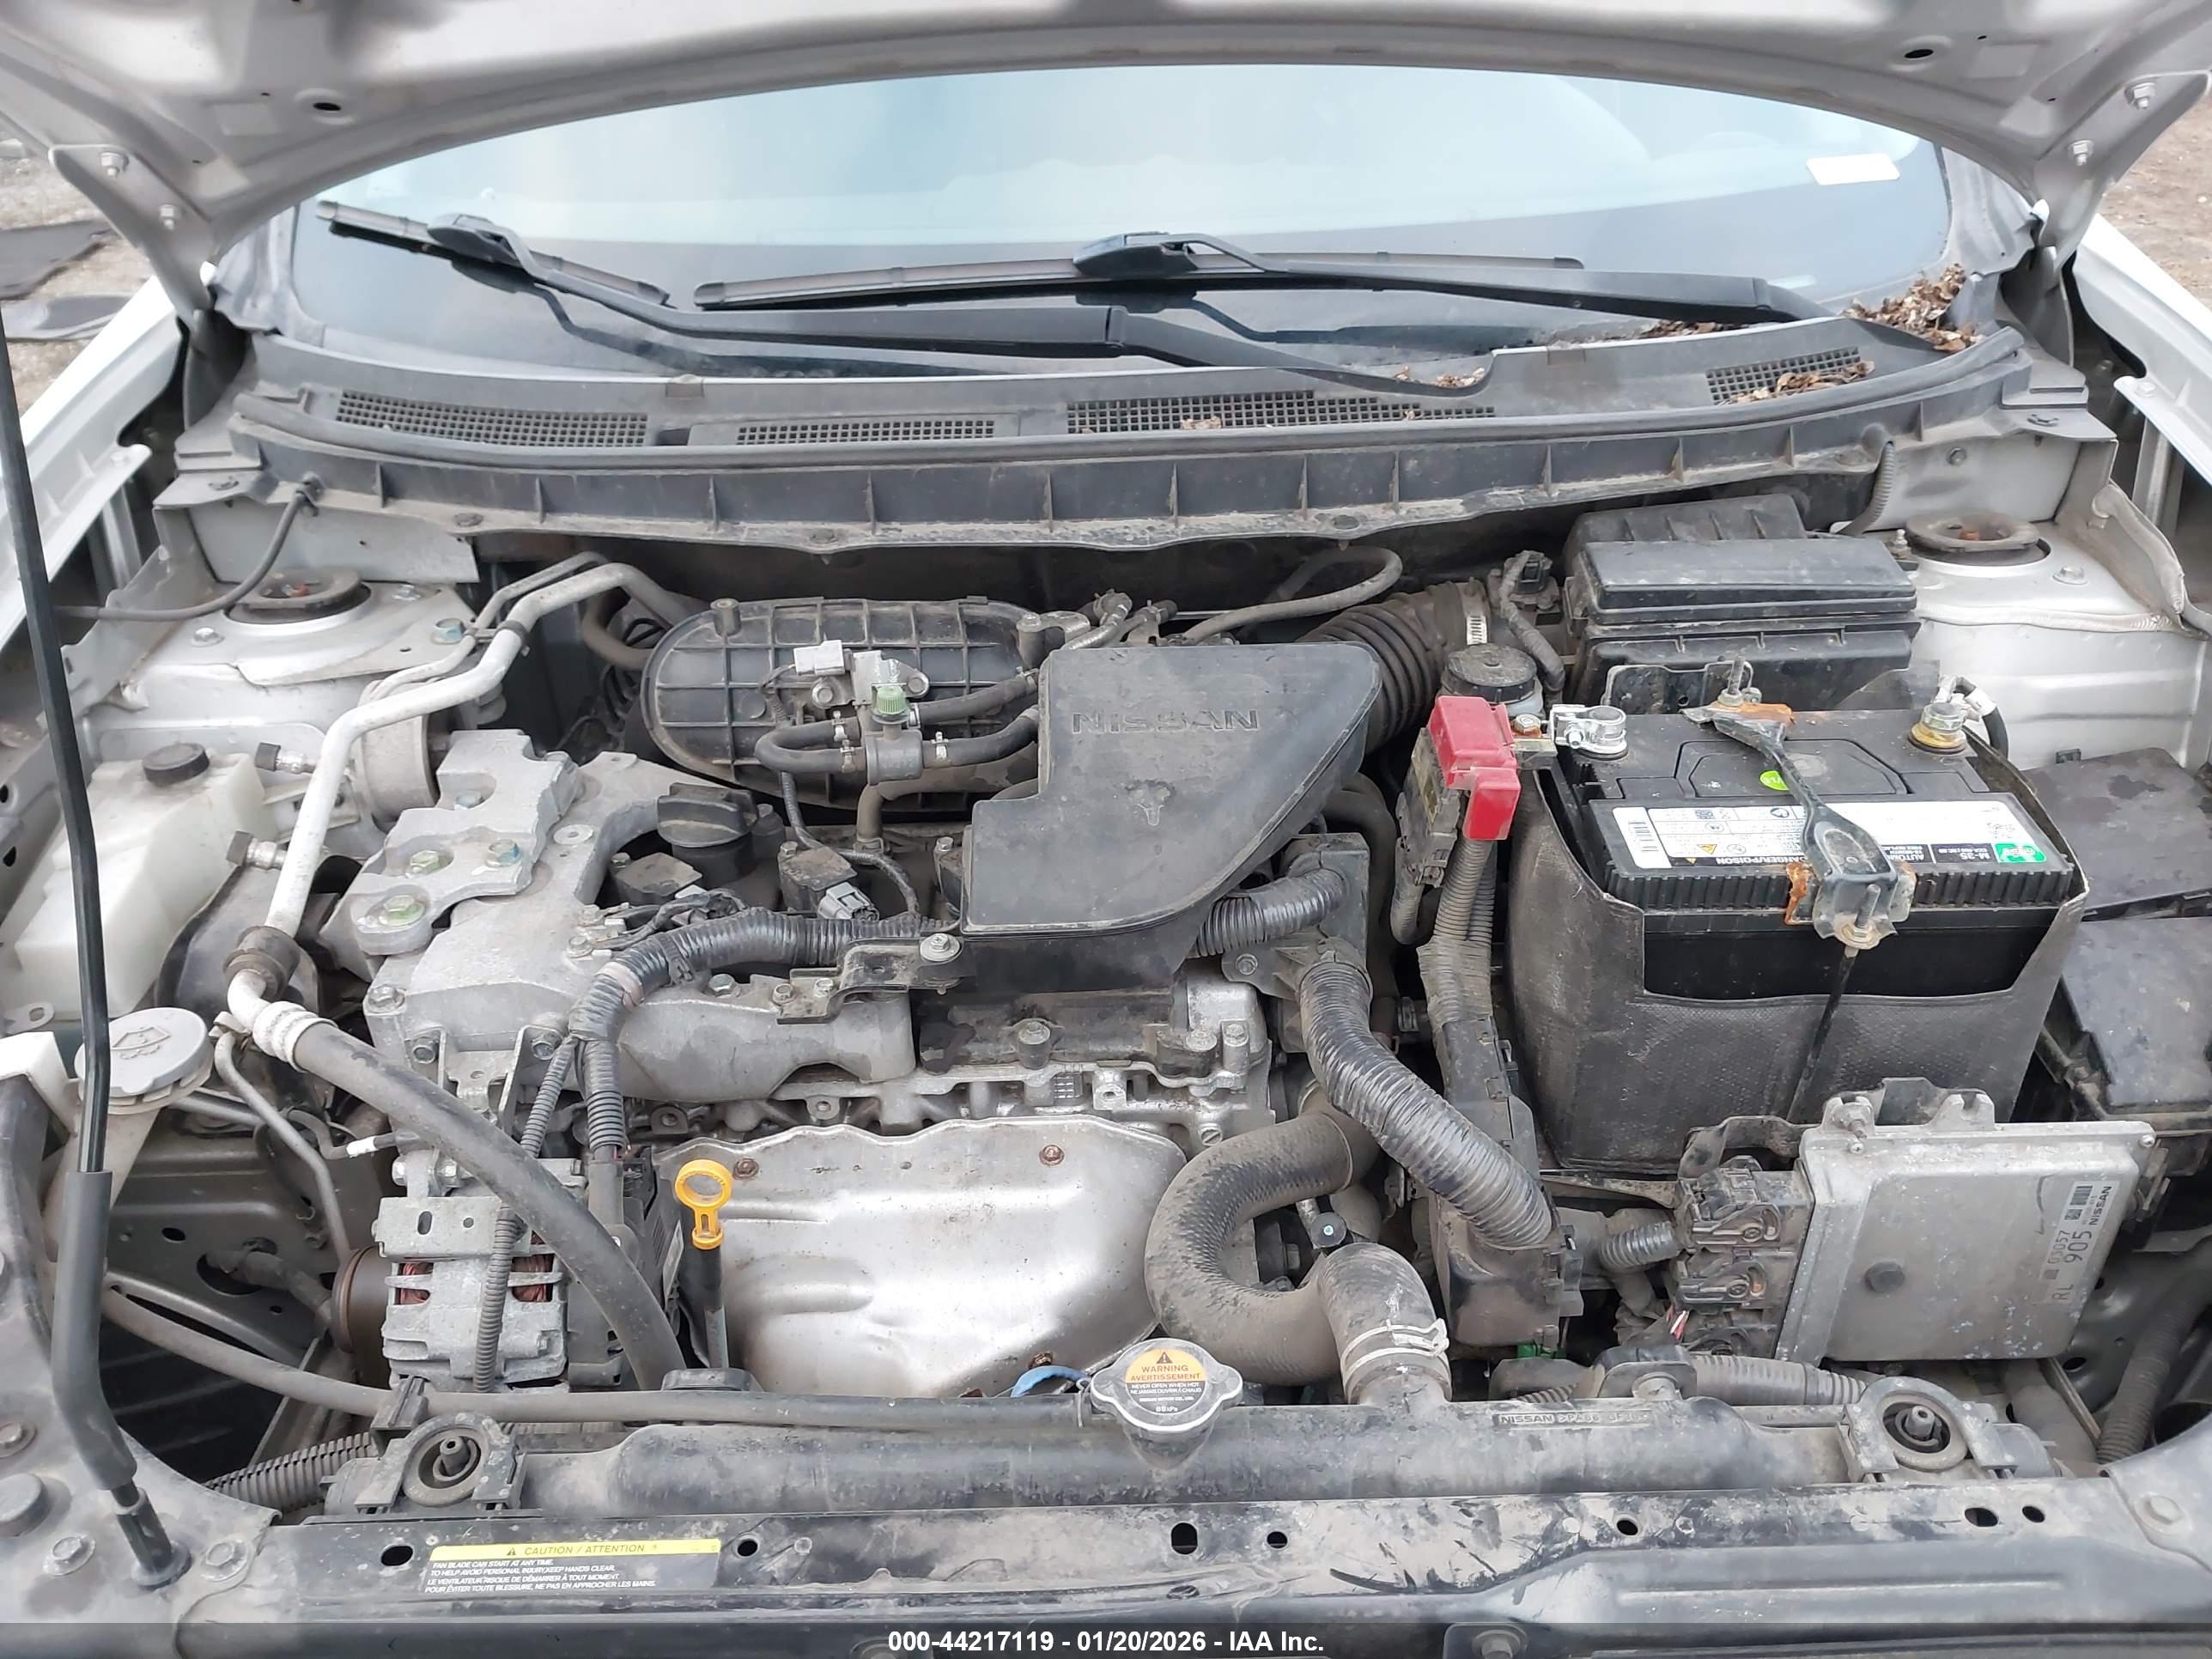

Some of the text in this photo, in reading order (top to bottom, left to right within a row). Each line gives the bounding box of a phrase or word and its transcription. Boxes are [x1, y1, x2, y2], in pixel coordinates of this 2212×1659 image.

[1073, 709, 1259, 733] NISSAN
[1716, 856, 1808, 865] DANGER/POISON
[2088, 1186, 2112, 1225] NISSAN
[2063, 1231, 2092, 1263] 905
[1141, 1364, 1188, 1373] WARNING
[1501, 1414, 1553, 1424] NISSAN
[524, 1547, 574, 1556] CAUTION
[585, 1544, 645, 1553] ATTENTION
